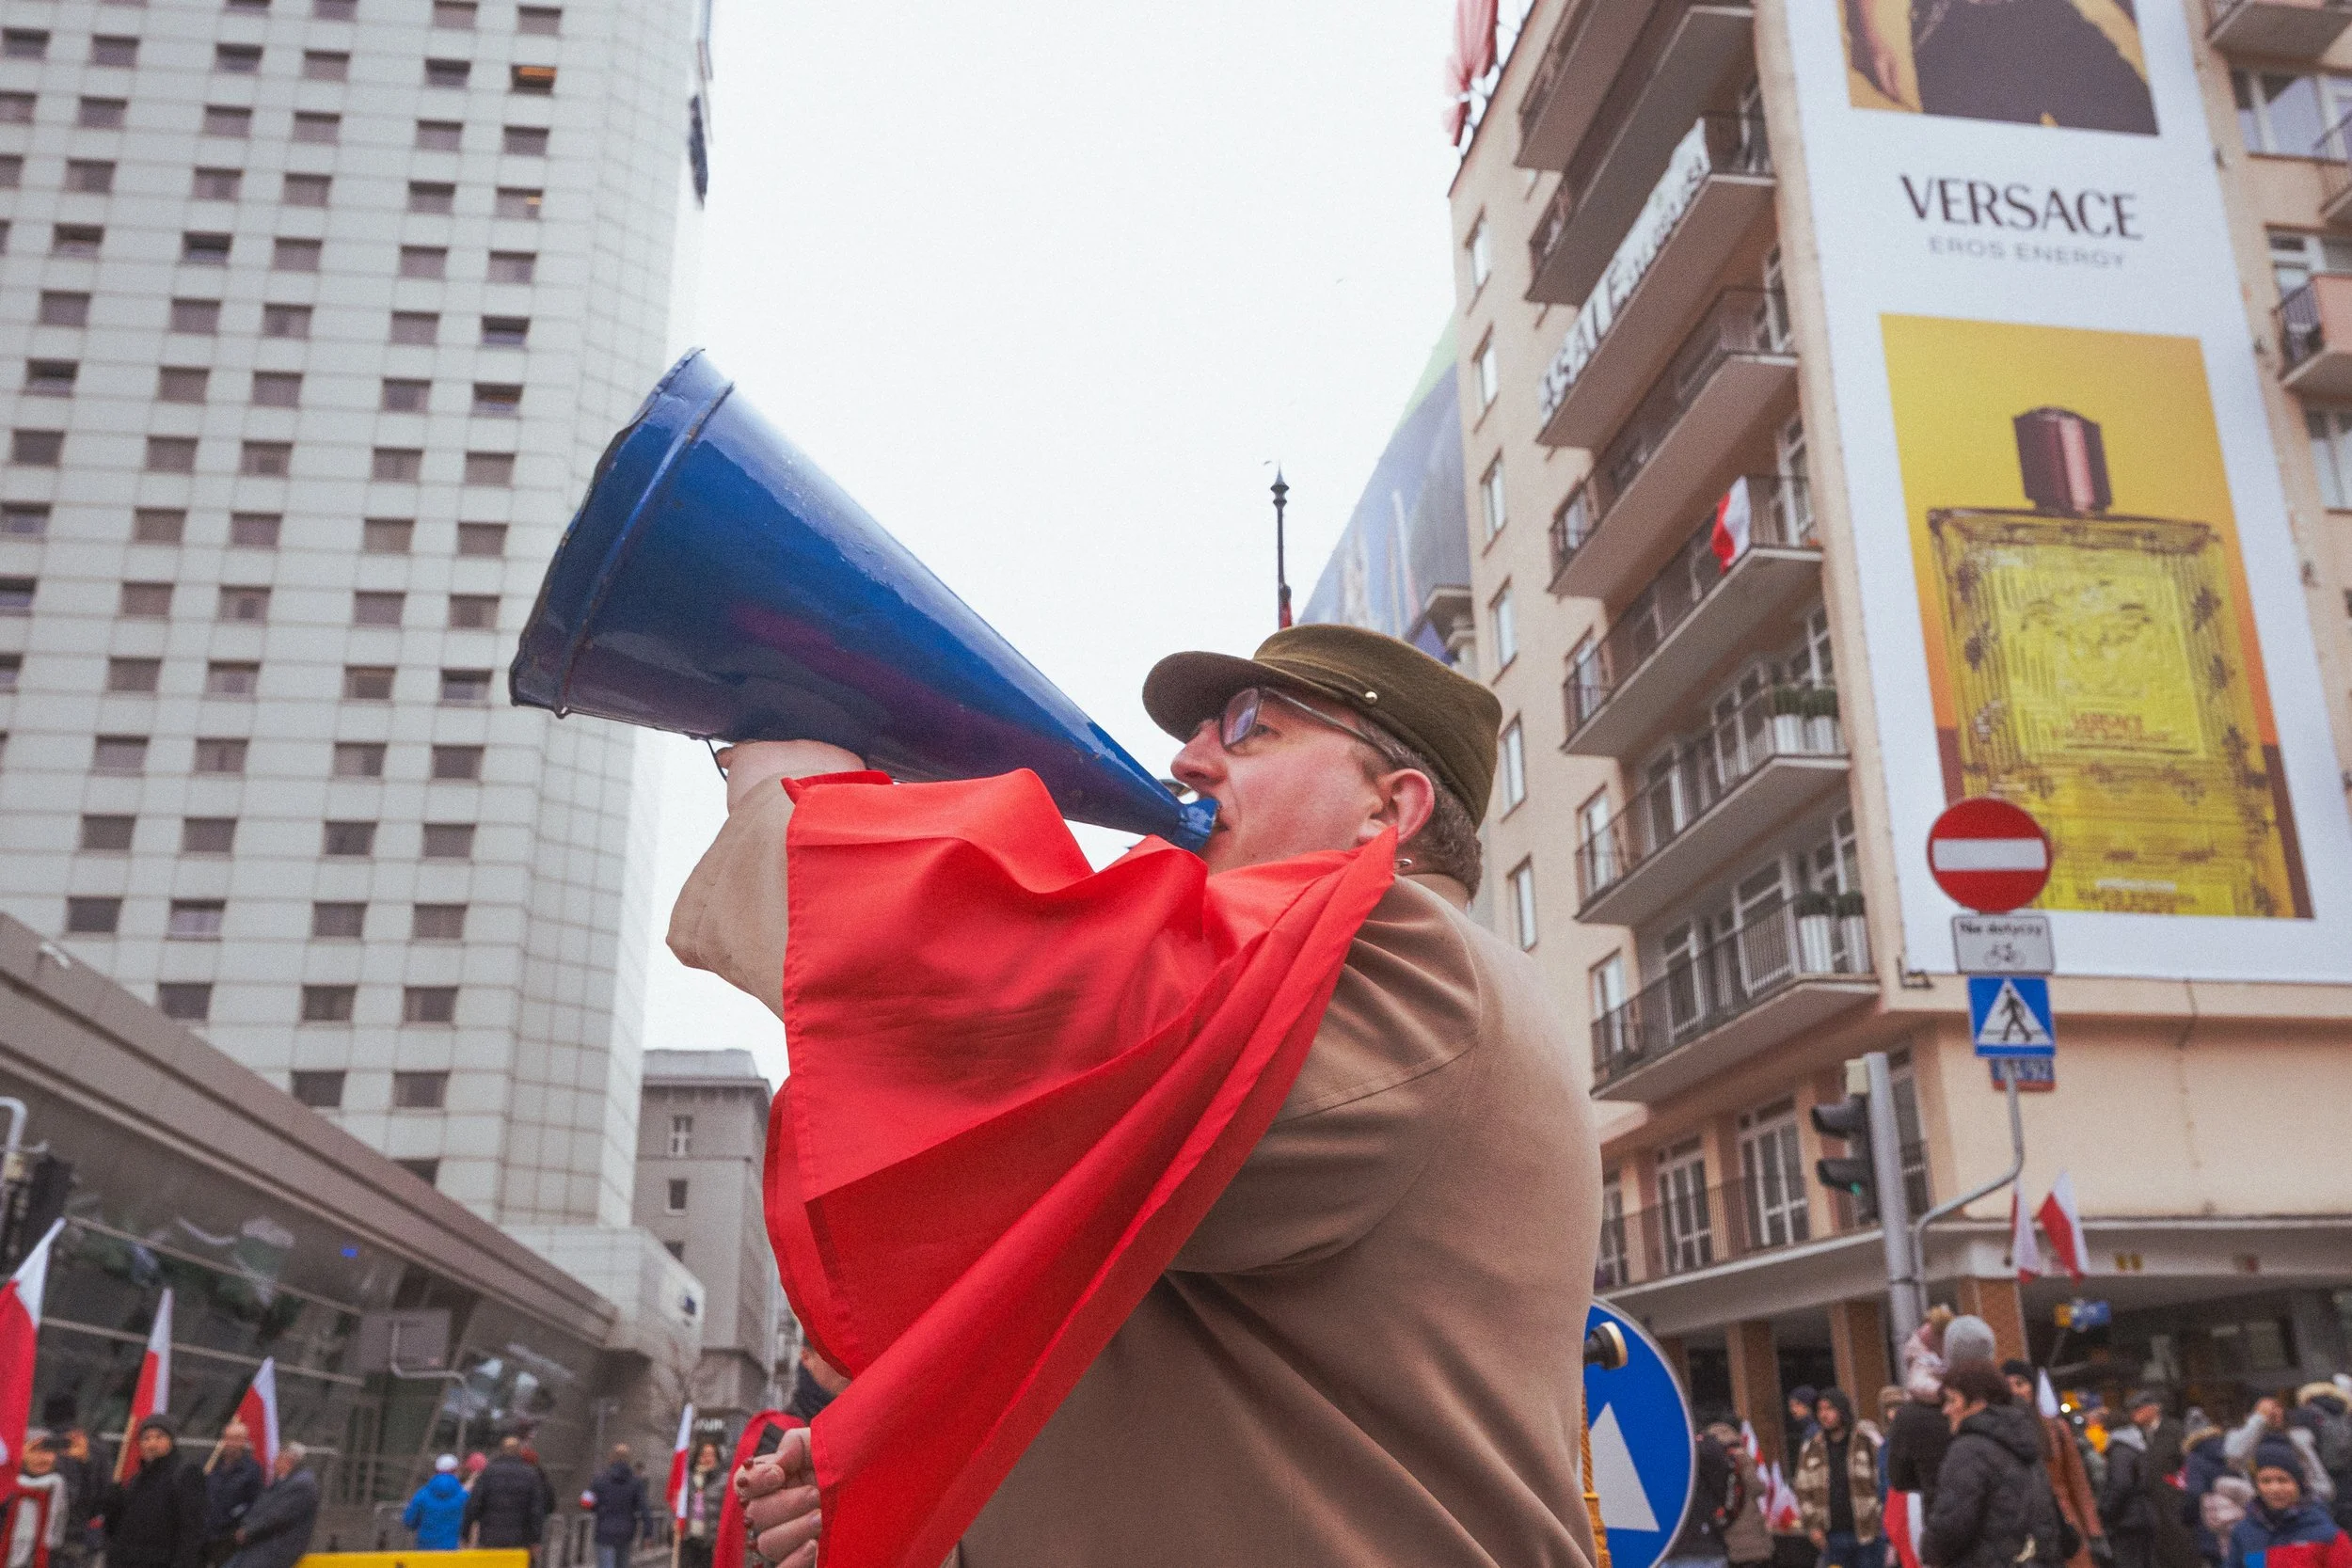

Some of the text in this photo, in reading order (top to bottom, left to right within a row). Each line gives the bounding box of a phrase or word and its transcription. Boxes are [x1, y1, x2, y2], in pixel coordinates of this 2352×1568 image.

[1899, 174, 2144, 241] VERSACE
[1929, 235, 2123, 268] EROS ENERGY
